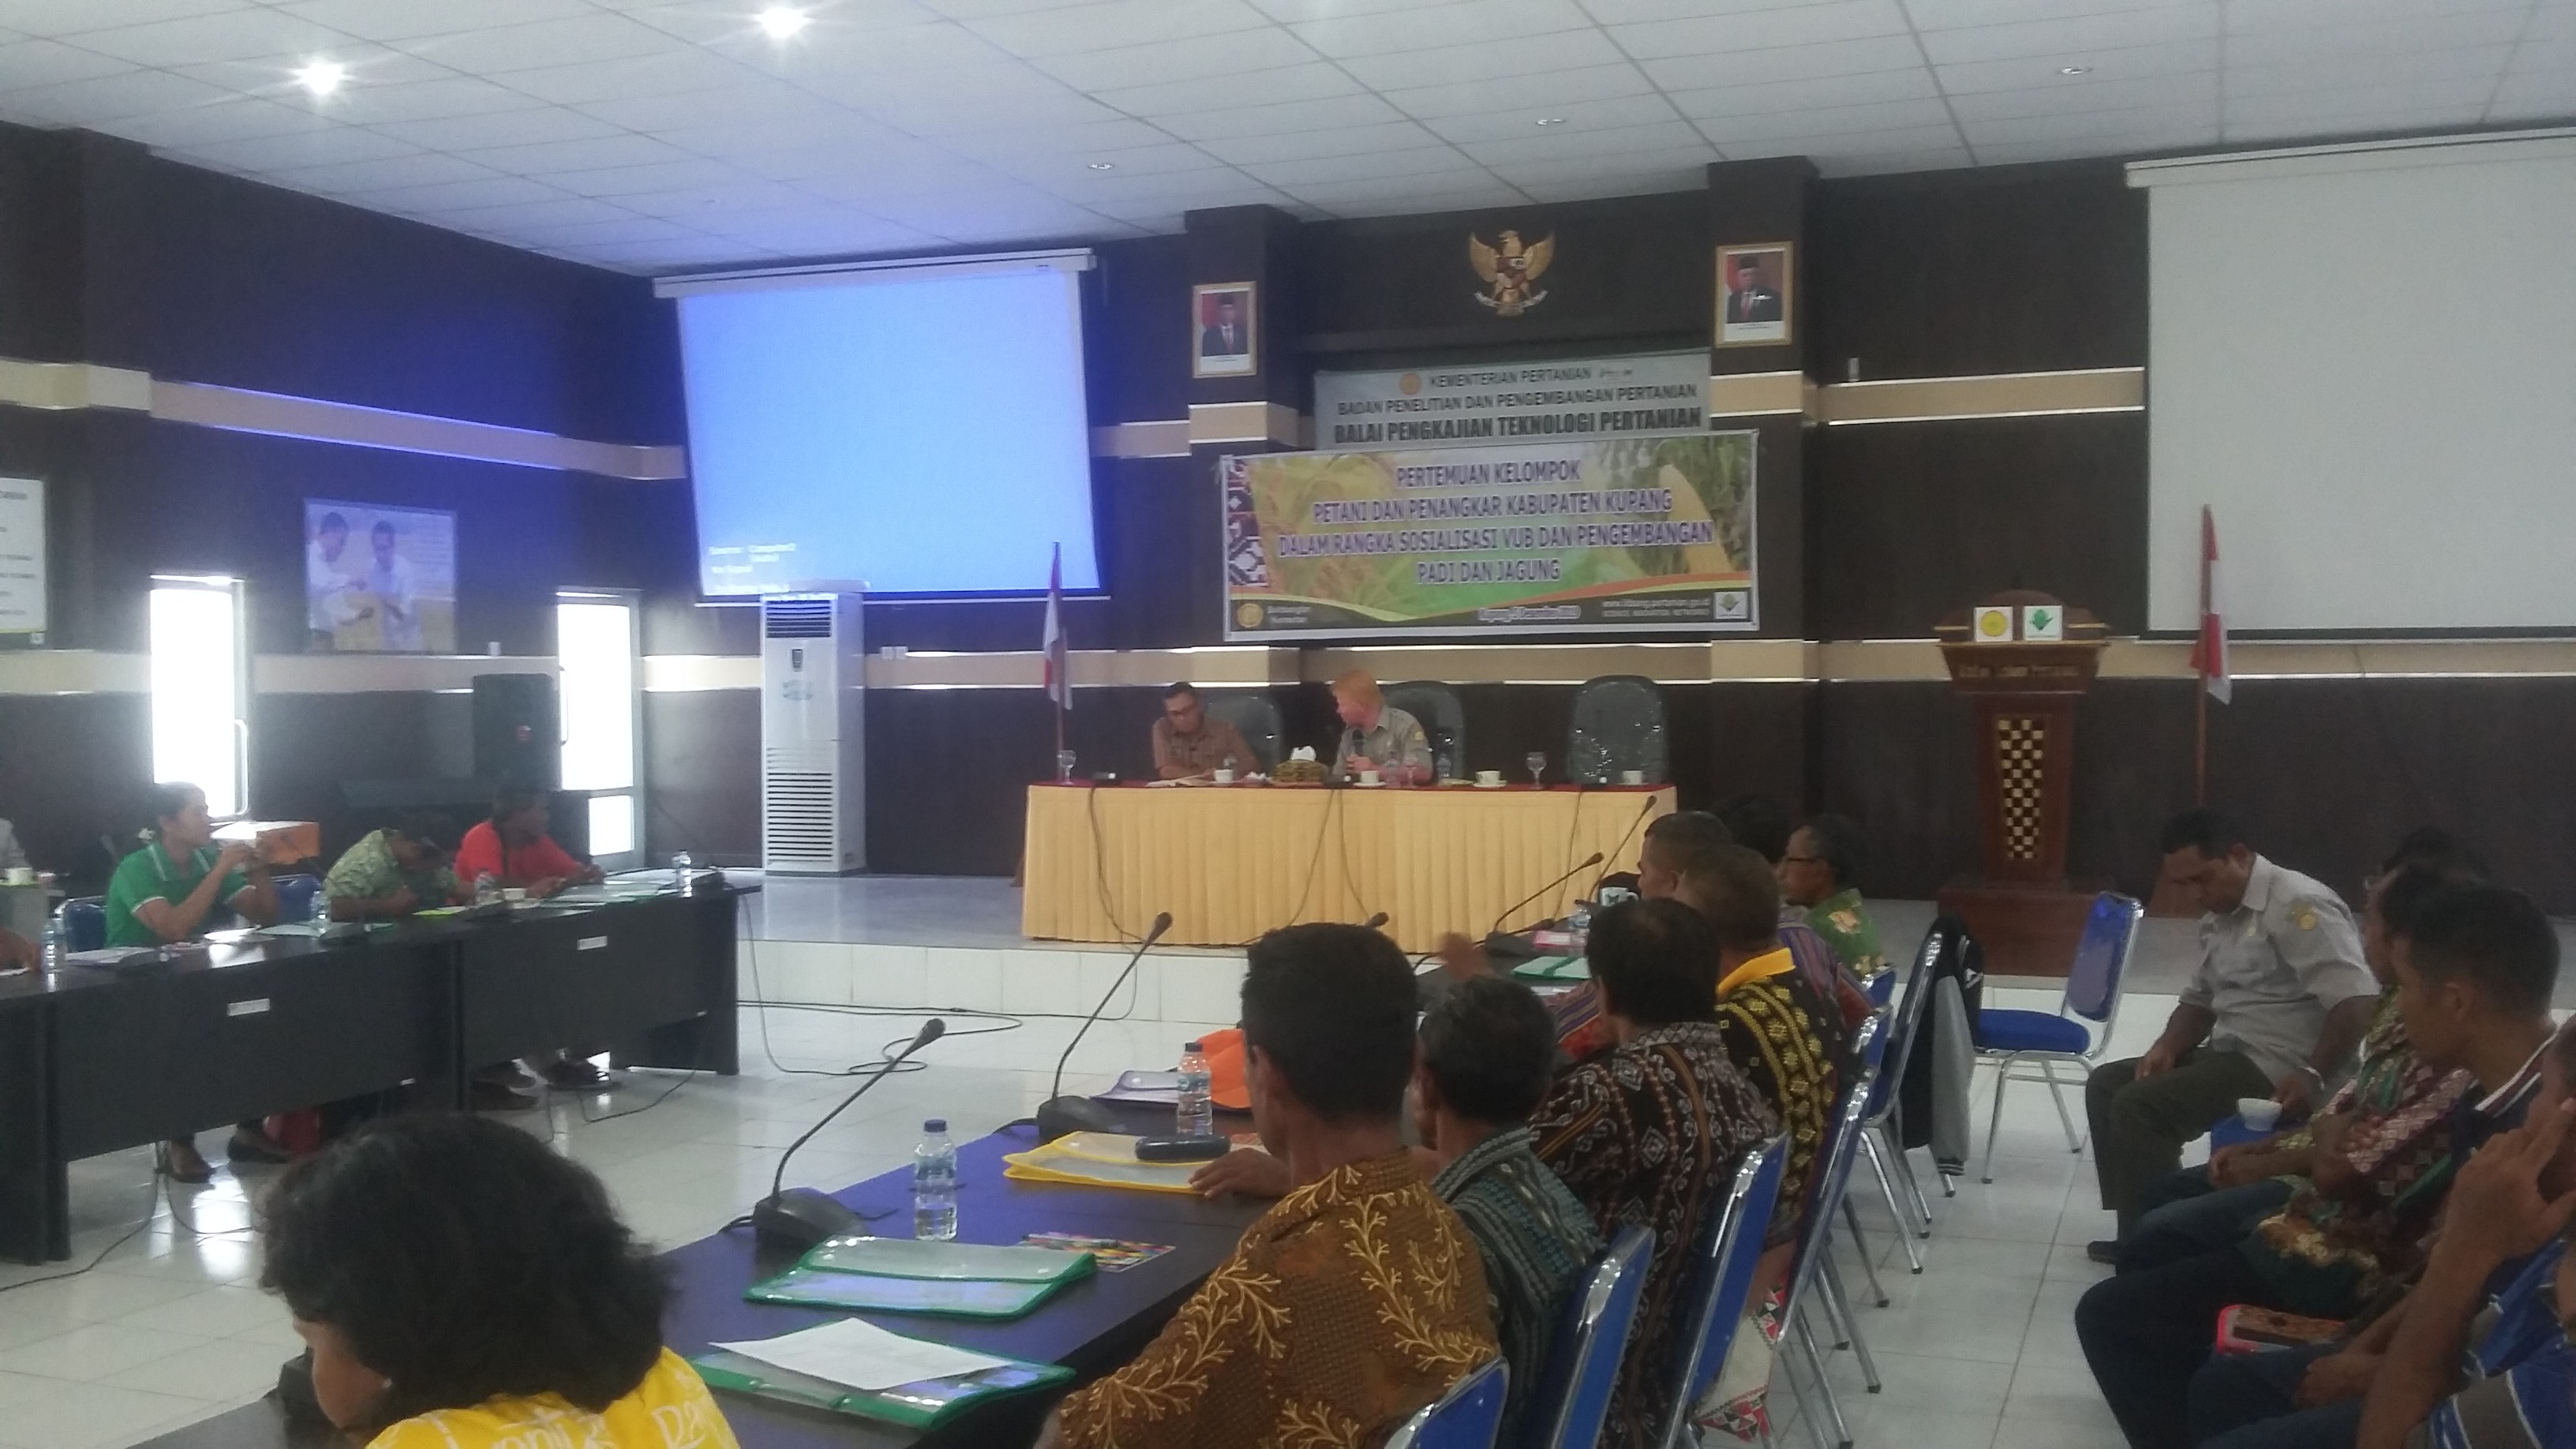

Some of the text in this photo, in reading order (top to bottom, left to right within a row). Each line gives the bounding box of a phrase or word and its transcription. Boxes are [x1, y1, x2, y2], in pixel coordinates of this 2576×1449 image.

[1429, 370, 1518, 388] KEMENTERIAN
[1522, 367, 1592, 384] PERTANIAN
[1339, 384, 1697, 415] BADAN PENELITIAN DAN PENGEMBANGAN PERTANIAN
[1335, 407, 1701, 444] BALAI PENGKAJIAN TEKNOLOGI PERTANIAN
[1397, 459, 1582, 488] PERTEMUAN KELOMPOK
[1313, 488, 1674, 523] PETANI DAN PENANGKAR KABUPATEN KUPANG
[1279, 520, 1715, 557] DALAM RANGKA SOSIALISASI VUB DAN PENGEMBANGAN
[1417, 557, 1562, 584] PADI DAN JAGUNG
